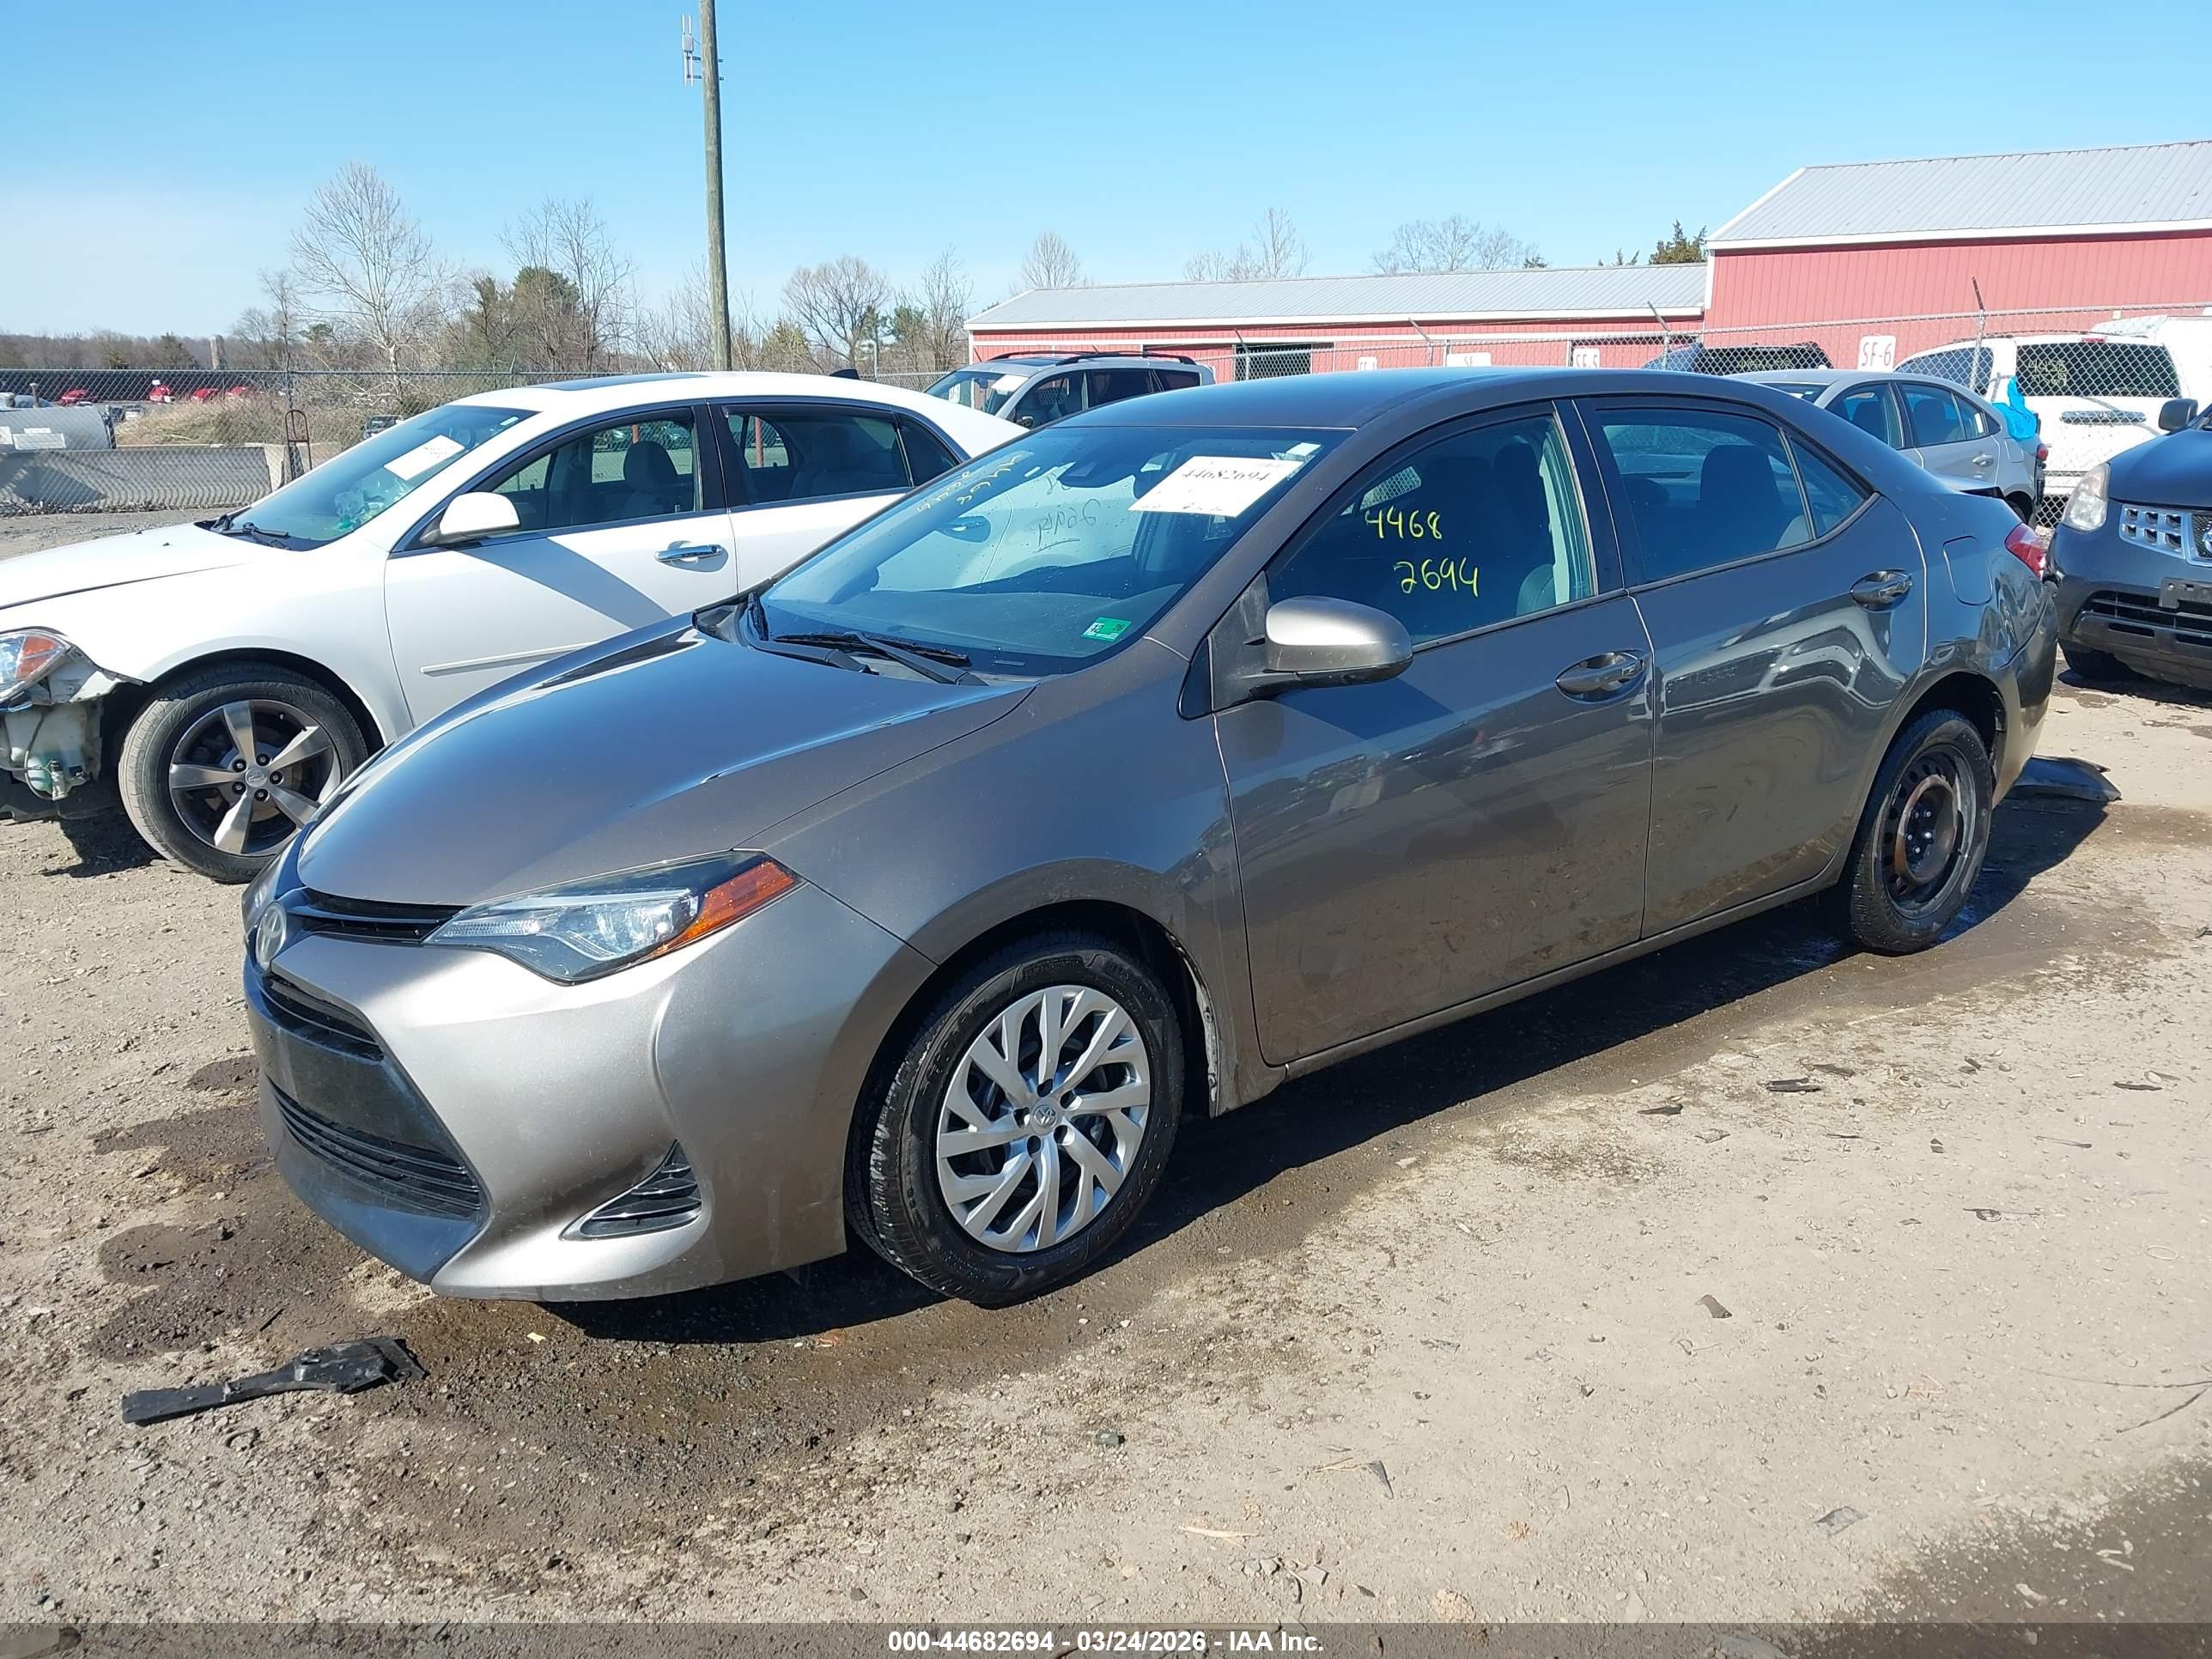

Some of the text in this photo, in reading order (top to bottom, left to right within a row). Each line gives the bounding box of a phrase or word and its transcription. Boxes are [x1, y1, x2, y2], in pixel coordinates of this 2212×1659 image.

[1862, 342, 1892, 367] SF-6
[1365, 505, 1443, 539] 4468
[1394, 557, 1480, 598] 2694
